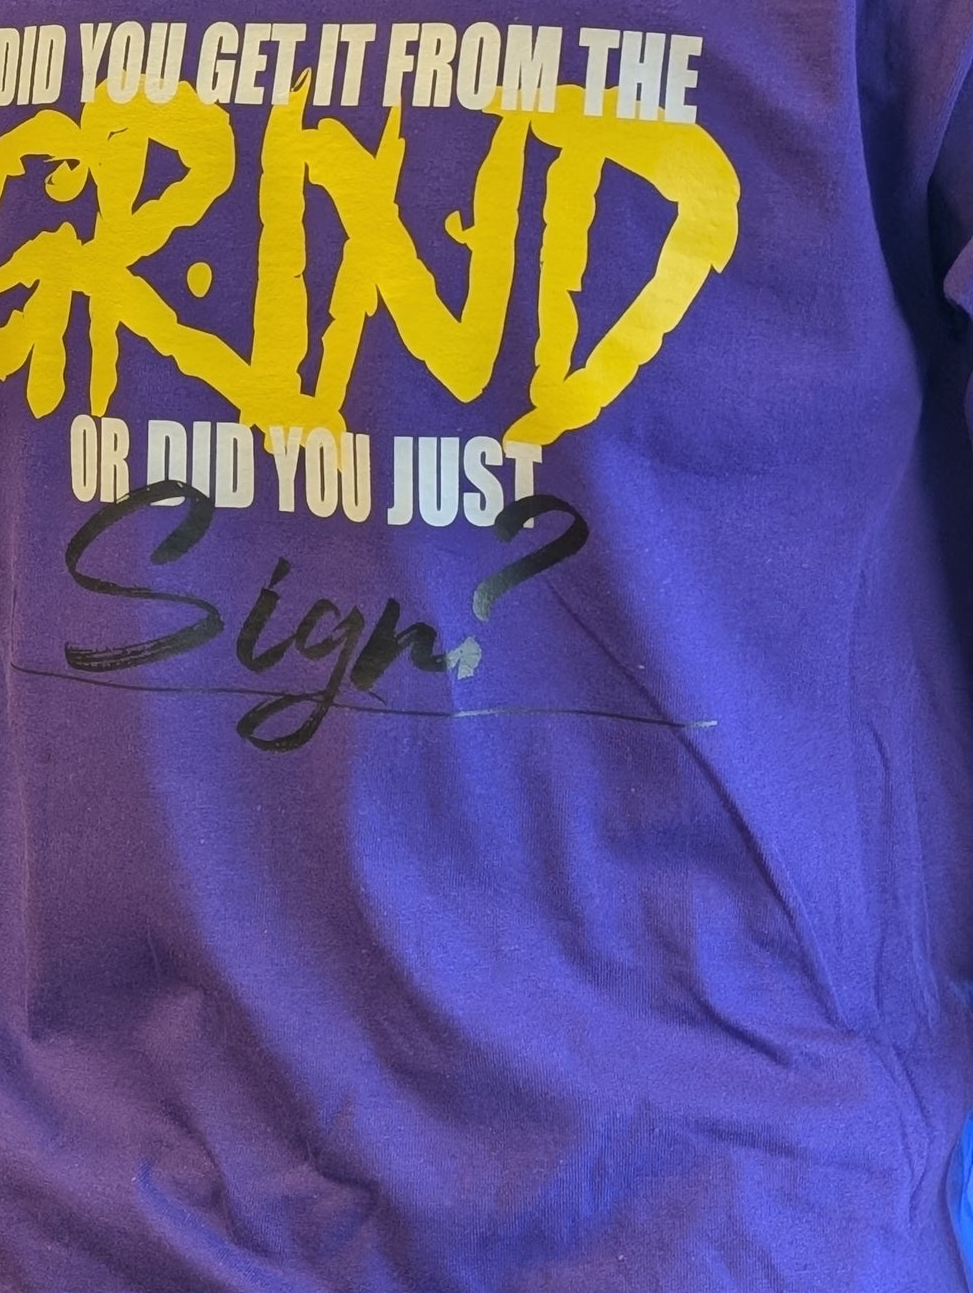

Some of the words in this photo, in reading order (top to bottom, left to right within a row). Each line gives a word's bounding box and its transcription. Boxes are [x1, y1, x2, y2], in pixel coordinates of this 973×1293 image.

[79, 21, 188, 105] YOU
[195, 21, 308, 106] GET
[313, 23, 377, 107] IT
[382, 21, 564, 114] FROM
[579, 27, 704, 124] THE
[70, 414, 130, 504] OR
[146, 419, 255, 508] DID
[268, 425, 372, 523] YOU
[386, 435, 543, 528] JUST
[64, 479, 591, 754] Sign?
